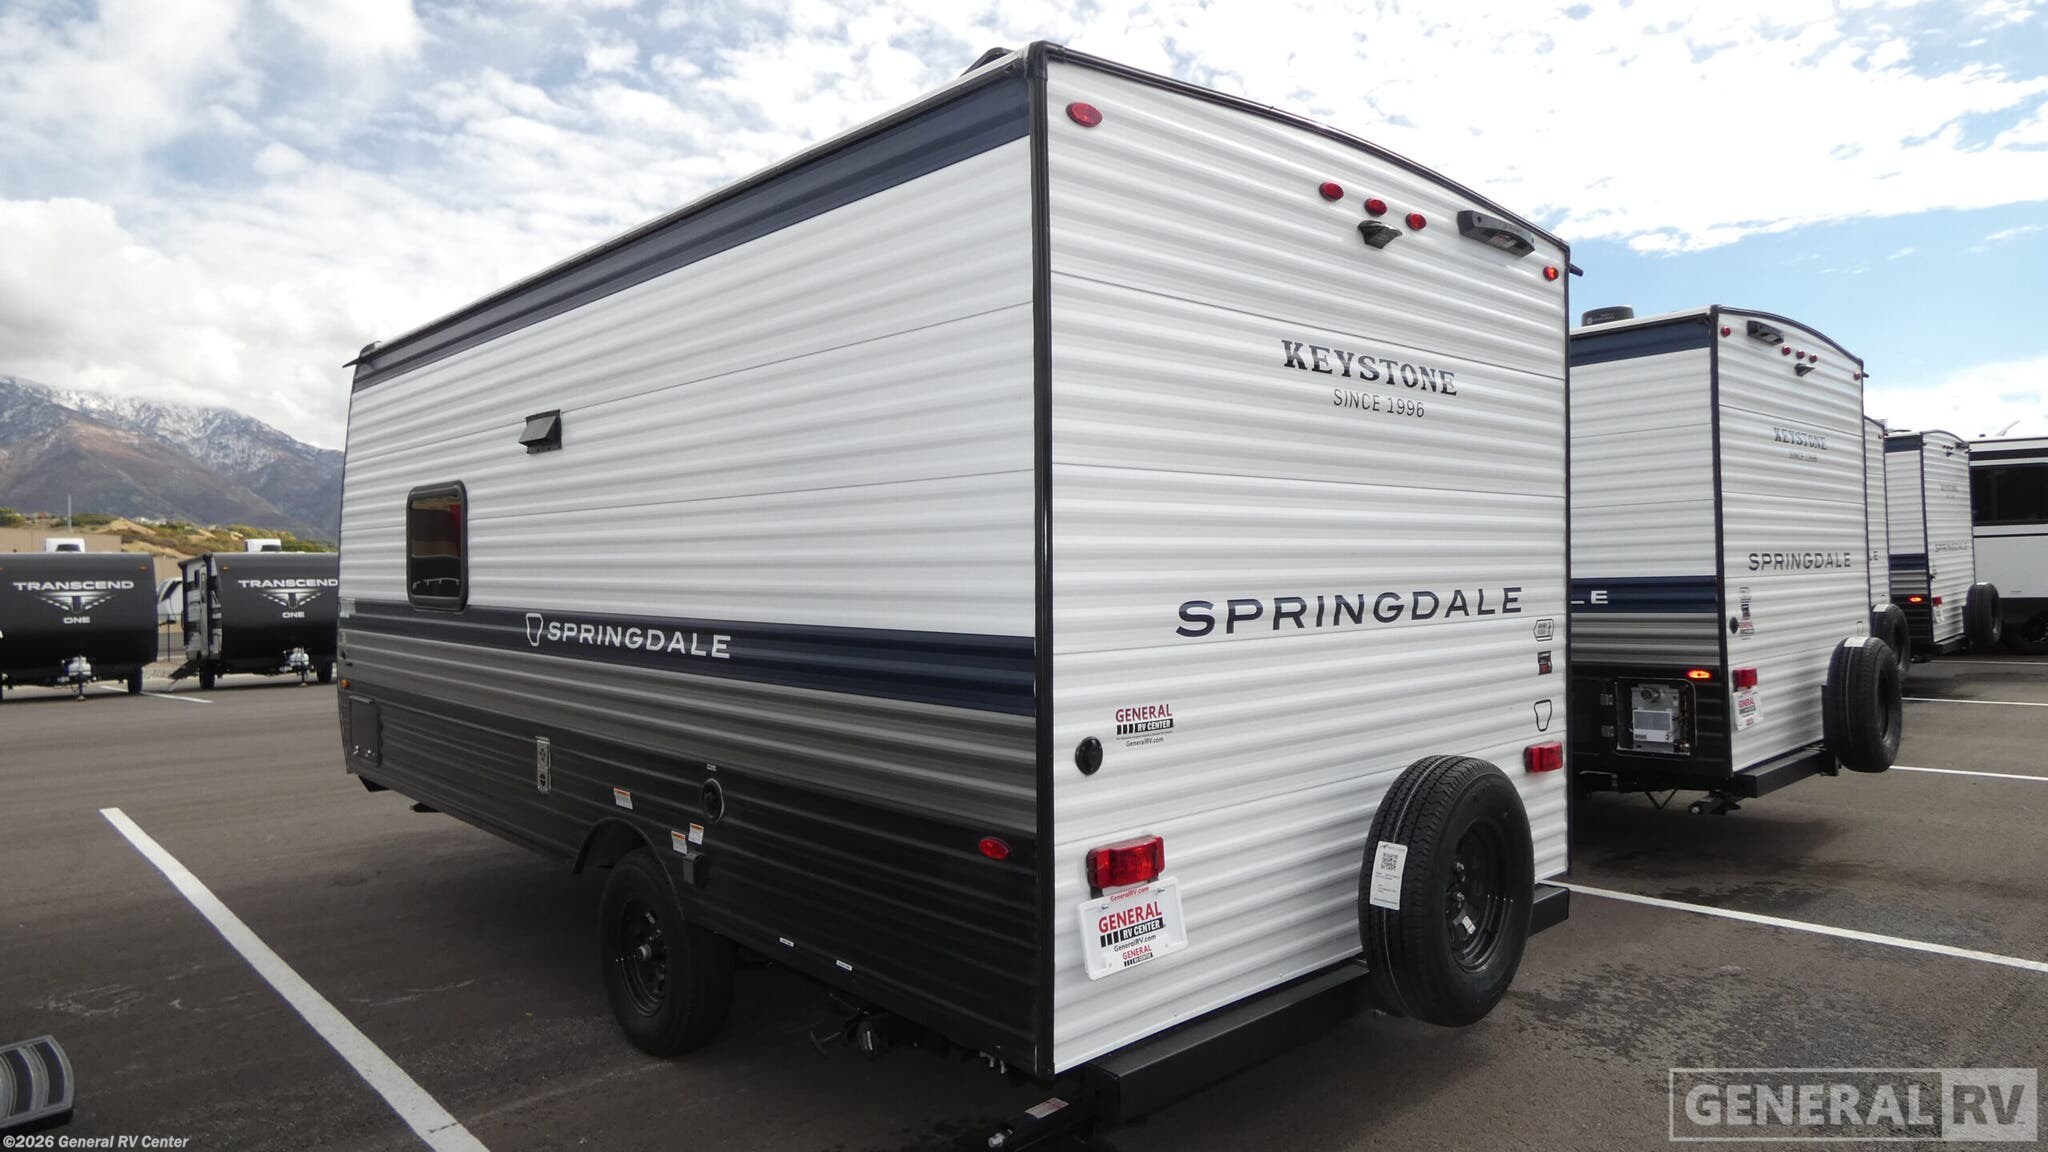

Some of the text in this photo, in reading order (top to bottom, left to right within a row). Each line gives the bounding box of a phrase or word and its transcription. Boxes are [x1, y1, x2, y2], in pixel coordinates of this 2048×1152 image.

[1281, 339, 1458, 396] KEYSTONE
[1333, 388, 1425, 418] SINCE 1996
[1748, 552, 1851, 571] SPRINGDALE
[13, 580, 135, 592] TRANSCEND
[238, 578, 339, 589] TRANSCEND
[63, 616, 91, 625] ONE
[281, 611, 305, 619] ONE
[1175, 586, 1523, 638] SPRINGDALE
[547, 621, 731, 659] SPRINGDALE
[1115, 703, 1173, 723] GENERAL
[1137, 719, 1171, 732] RV CENTER
[1110, 886, 1150, 902] GeneralRV.com
[1098, 901, 1162, 933] GENERAL
[1122, 919, 1161, 939] RV CENTER
[1113, 934, 1157, 952] GeneralRV.com
[1122, 944, 1152, 960] GENERAL
